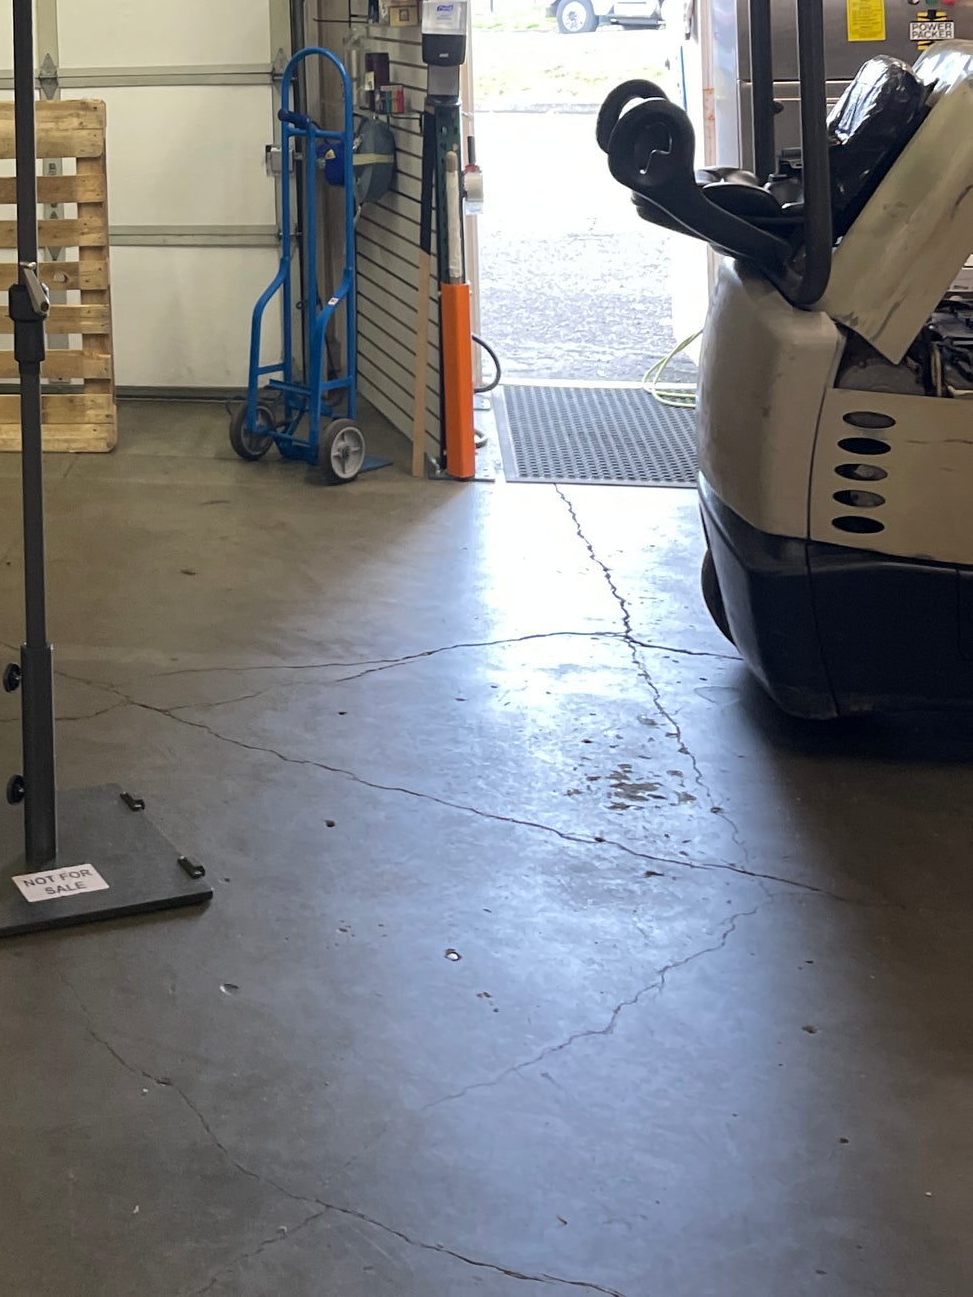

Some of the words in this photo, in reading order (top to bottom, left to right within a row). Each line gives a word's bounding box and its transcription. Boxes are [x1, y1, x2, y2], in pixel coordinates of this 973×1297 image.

[912, 23, 952, 31] POWER
[912, 30, 953, 39] PACKER
[23, 875, 56, 887] NOT
[59, 868, 93, 881] FOR
[45, 881, 88, 895] SALE
